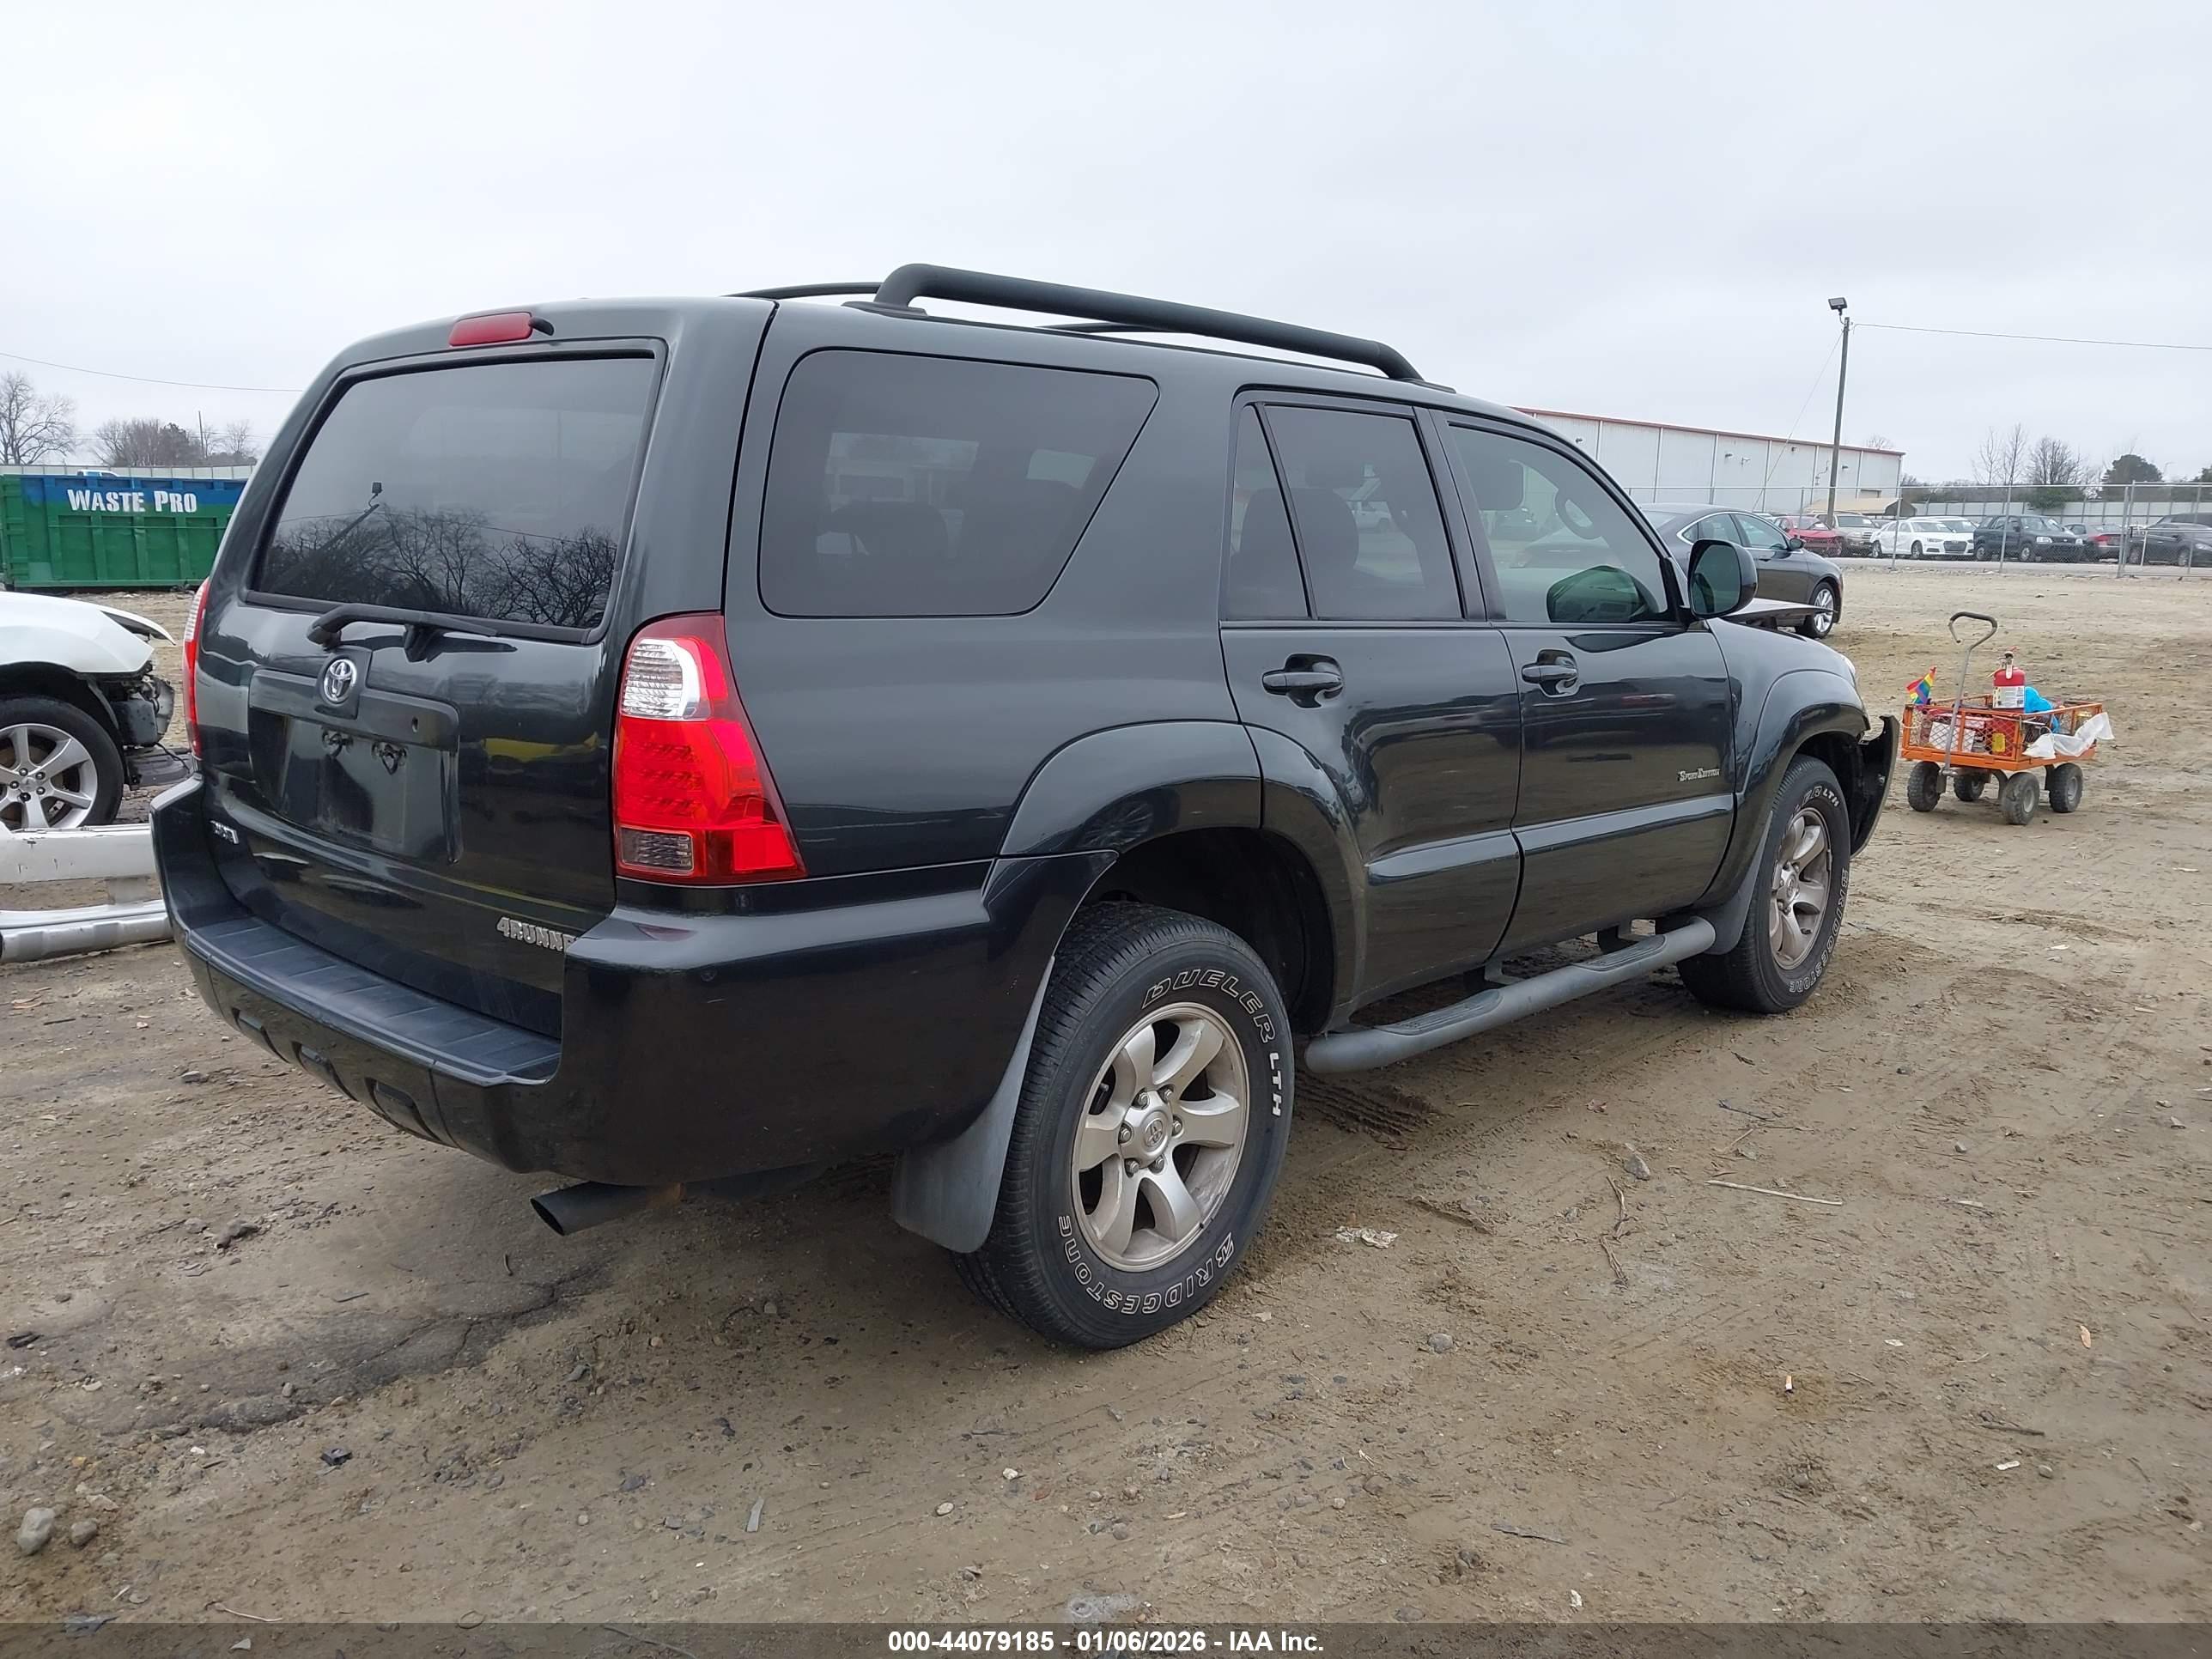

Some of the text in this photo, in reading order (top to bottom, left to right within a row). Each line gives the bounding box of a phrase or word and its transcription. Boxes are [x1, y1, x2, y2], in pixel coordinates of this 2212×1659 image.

[67, 489, 198, 514] WASTE PRO
[496, 916, 577, 952] 4RUNN
[1141, 969, 1283, 1116] DUELER LTH
[1058, 1215, 1235, 1315] BRIDGESTONE
